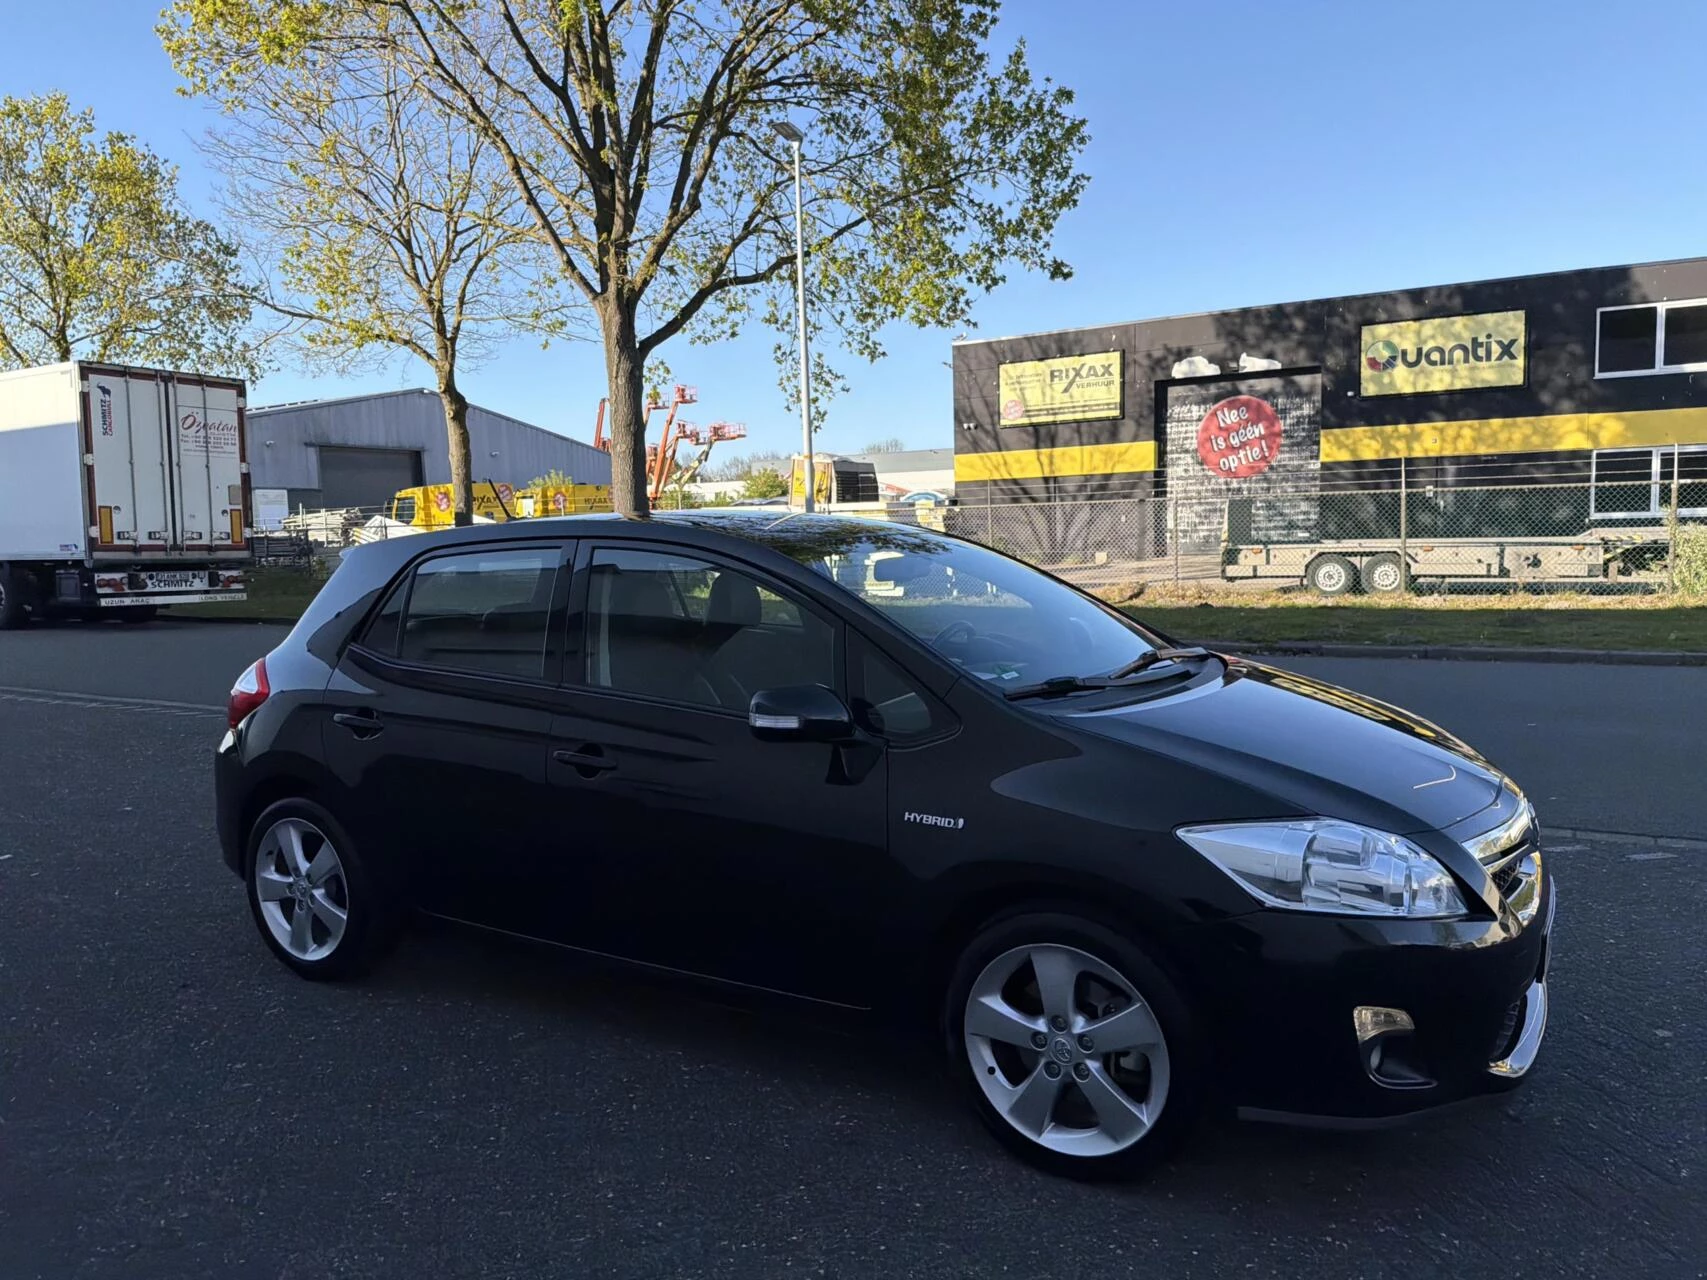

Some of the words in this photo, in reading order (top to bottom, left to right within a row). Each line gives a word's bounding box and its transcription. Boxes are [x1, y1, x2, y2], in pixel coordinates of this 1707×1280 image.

[1366, 333, 1519, 373] Quantix
[1050, 363, 1114, 394] RIXAX
[1076, 379, 1115, 390] VERHUUR
[101, 398, 109, 436] SCHMITZ
[1216, 406, 1249, 428] Nee
[1210, 434, 1227, 453] is
[1229, 421, 1266, 448] géén
[1219, 439, 1270, 473] optie!
[151, 580, 195, 589] SCHMITZ
[904, 811, 954, 828] HYBRID
